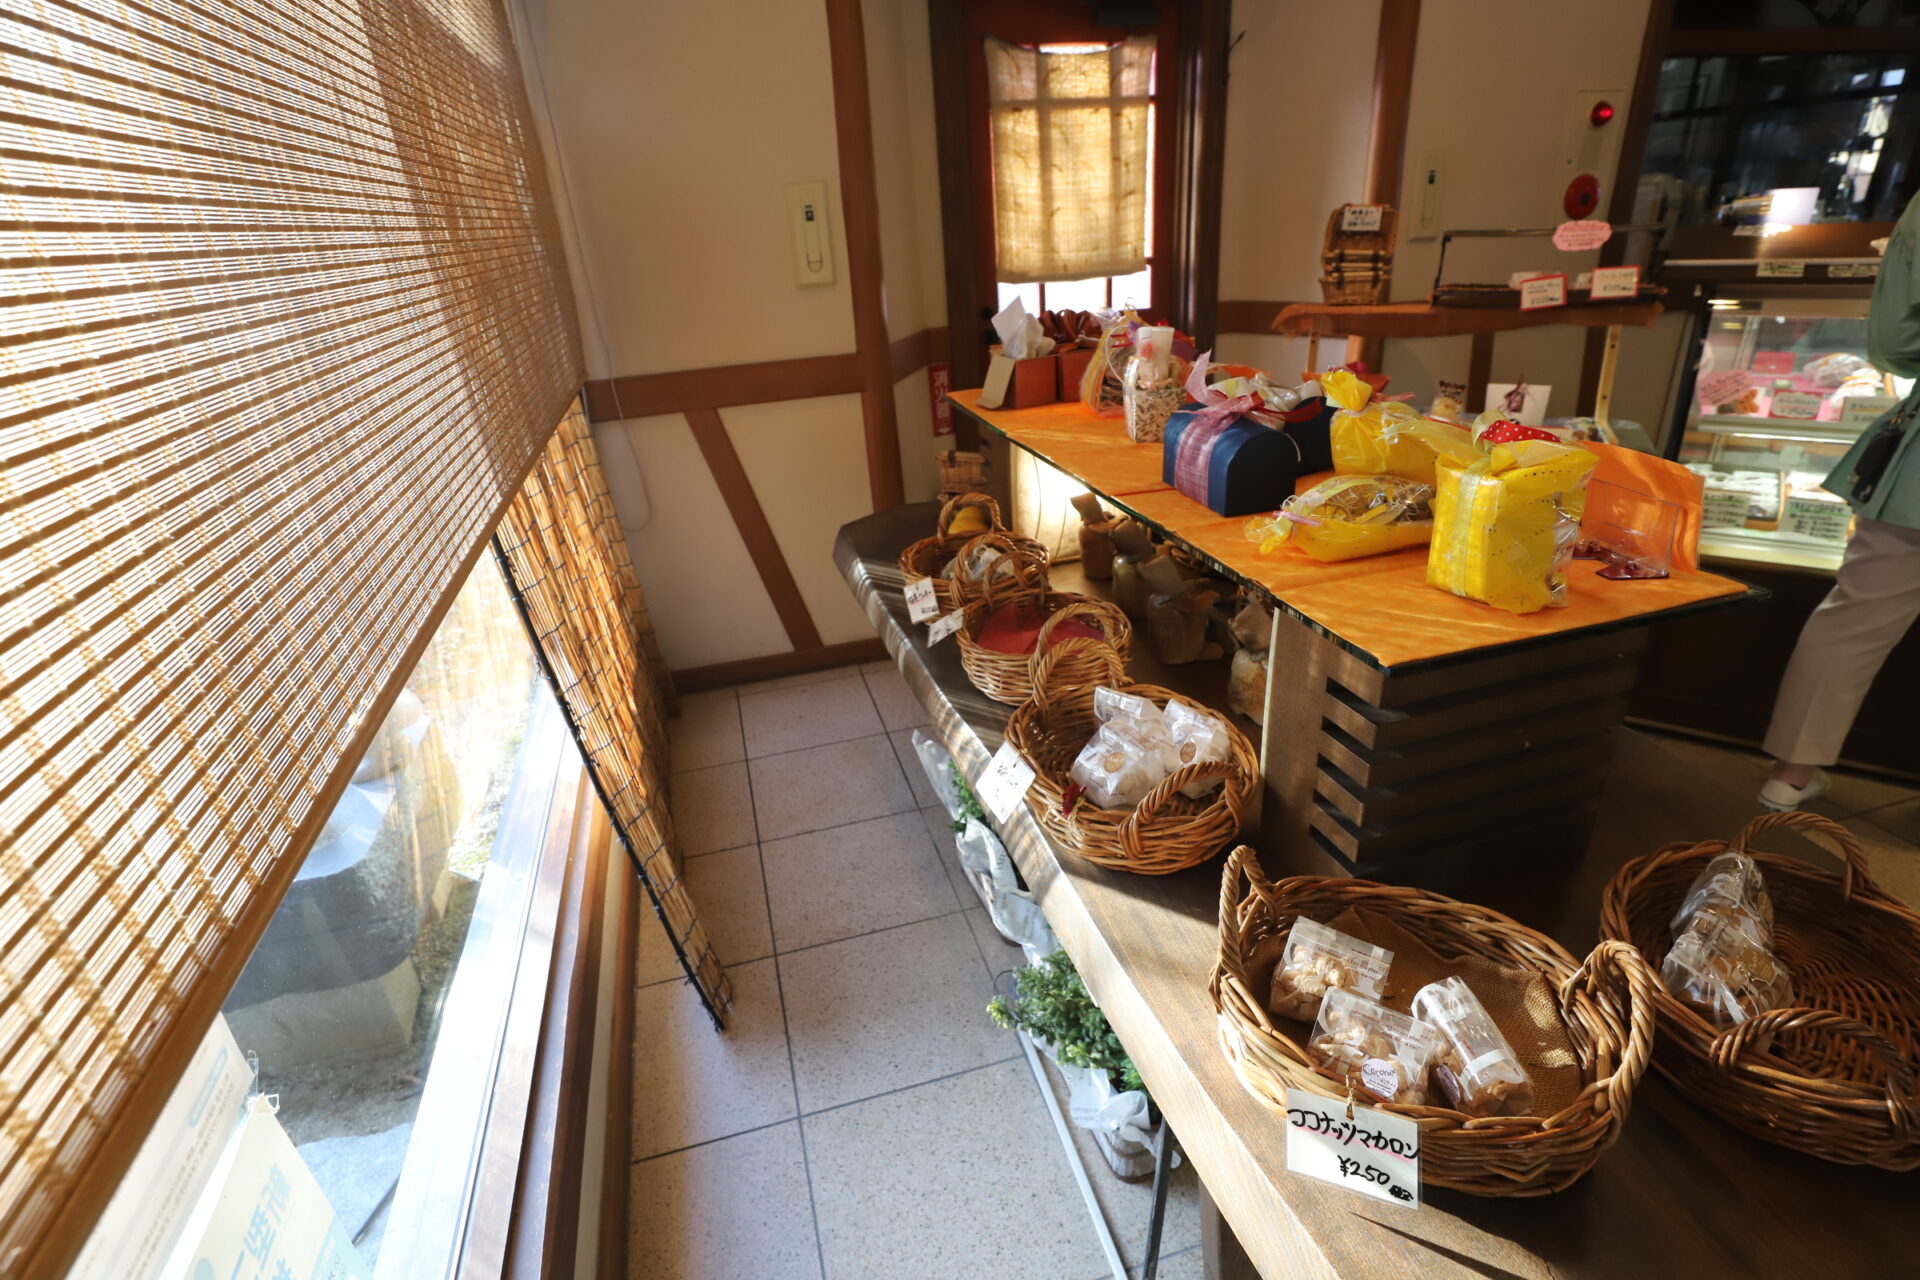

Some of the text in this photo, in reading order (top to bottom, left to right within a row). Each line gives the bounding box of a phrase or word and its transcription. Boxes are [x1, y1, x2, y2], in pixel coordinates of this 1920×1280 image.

[1287, 1109, 1420, 1159] ココナッツマカロン
[1338, 1155, 1390, 1185] ¥250
